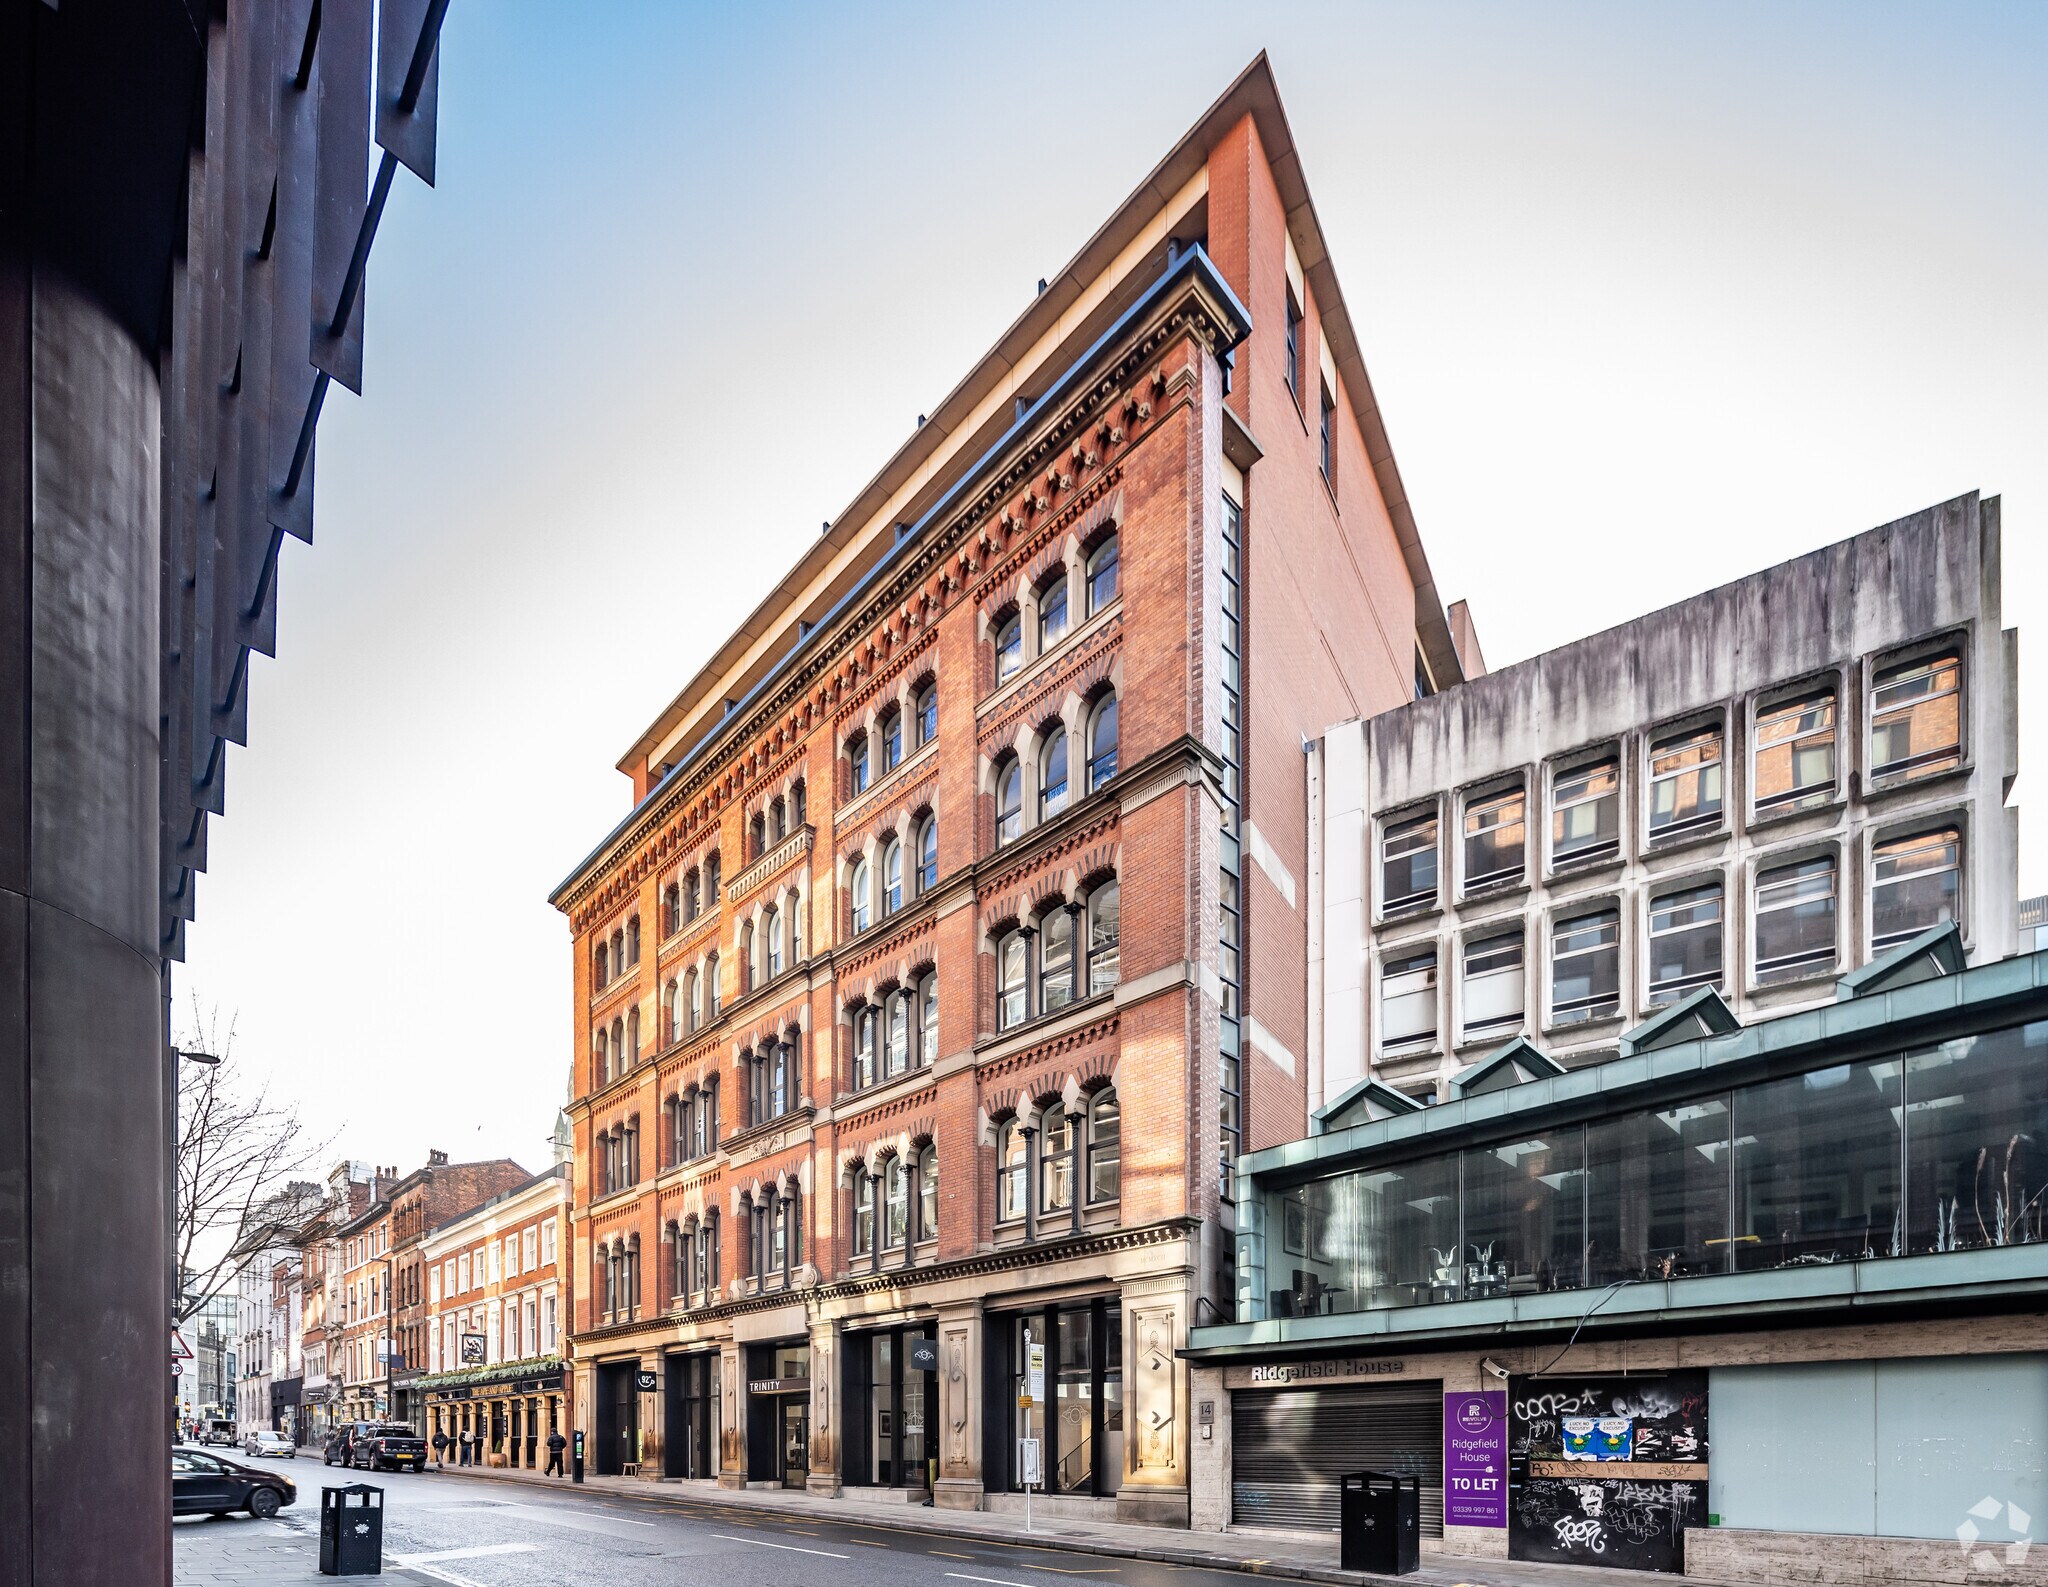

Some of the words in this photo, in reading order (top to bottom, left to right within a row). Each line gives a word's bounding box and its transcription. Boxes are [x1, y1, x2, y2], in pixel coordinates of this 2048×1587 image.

[1251, 1361, 1338, 1382] Ridgefield
[1344, 1360, 1403, 1375] House
[750, 1381, 780, 1392] TRINITY
[1201, 1405, 1211, 1414] 14
[1452, 1439, 1498, 1450] Ridgefield
[1460, 1453, 1490, 1461] House
[1452, 1478, 1470, 1490] TO
[1474, 1478, 1499, 1490] LET
